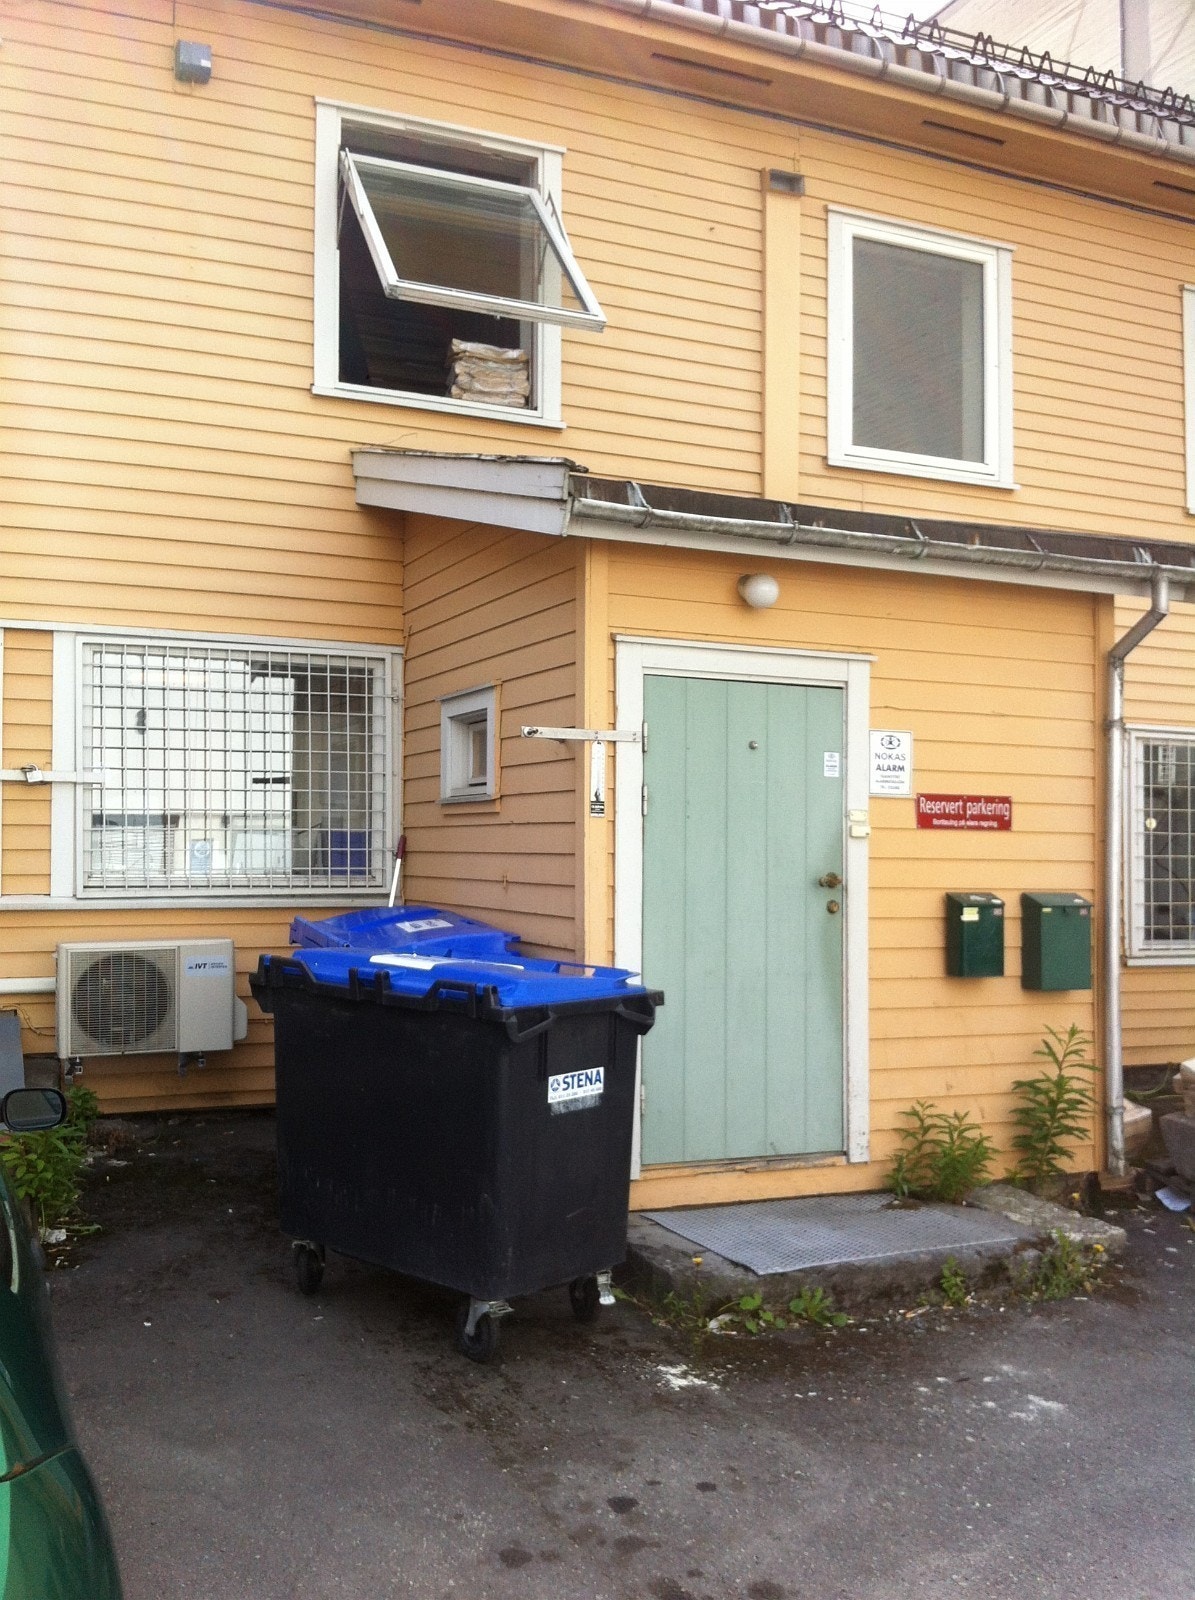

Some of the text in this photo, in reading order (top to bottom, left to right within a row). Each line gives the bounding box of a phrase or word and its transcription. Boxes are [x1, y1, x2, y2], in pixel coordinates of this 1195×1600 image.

[874, 752, 906, 761] NOKAS
[876, 763, 905, 772] ALARM
[919, 796, 1010, 820] Reservert parkering
[562, 1069, 602, 1092] STENA
